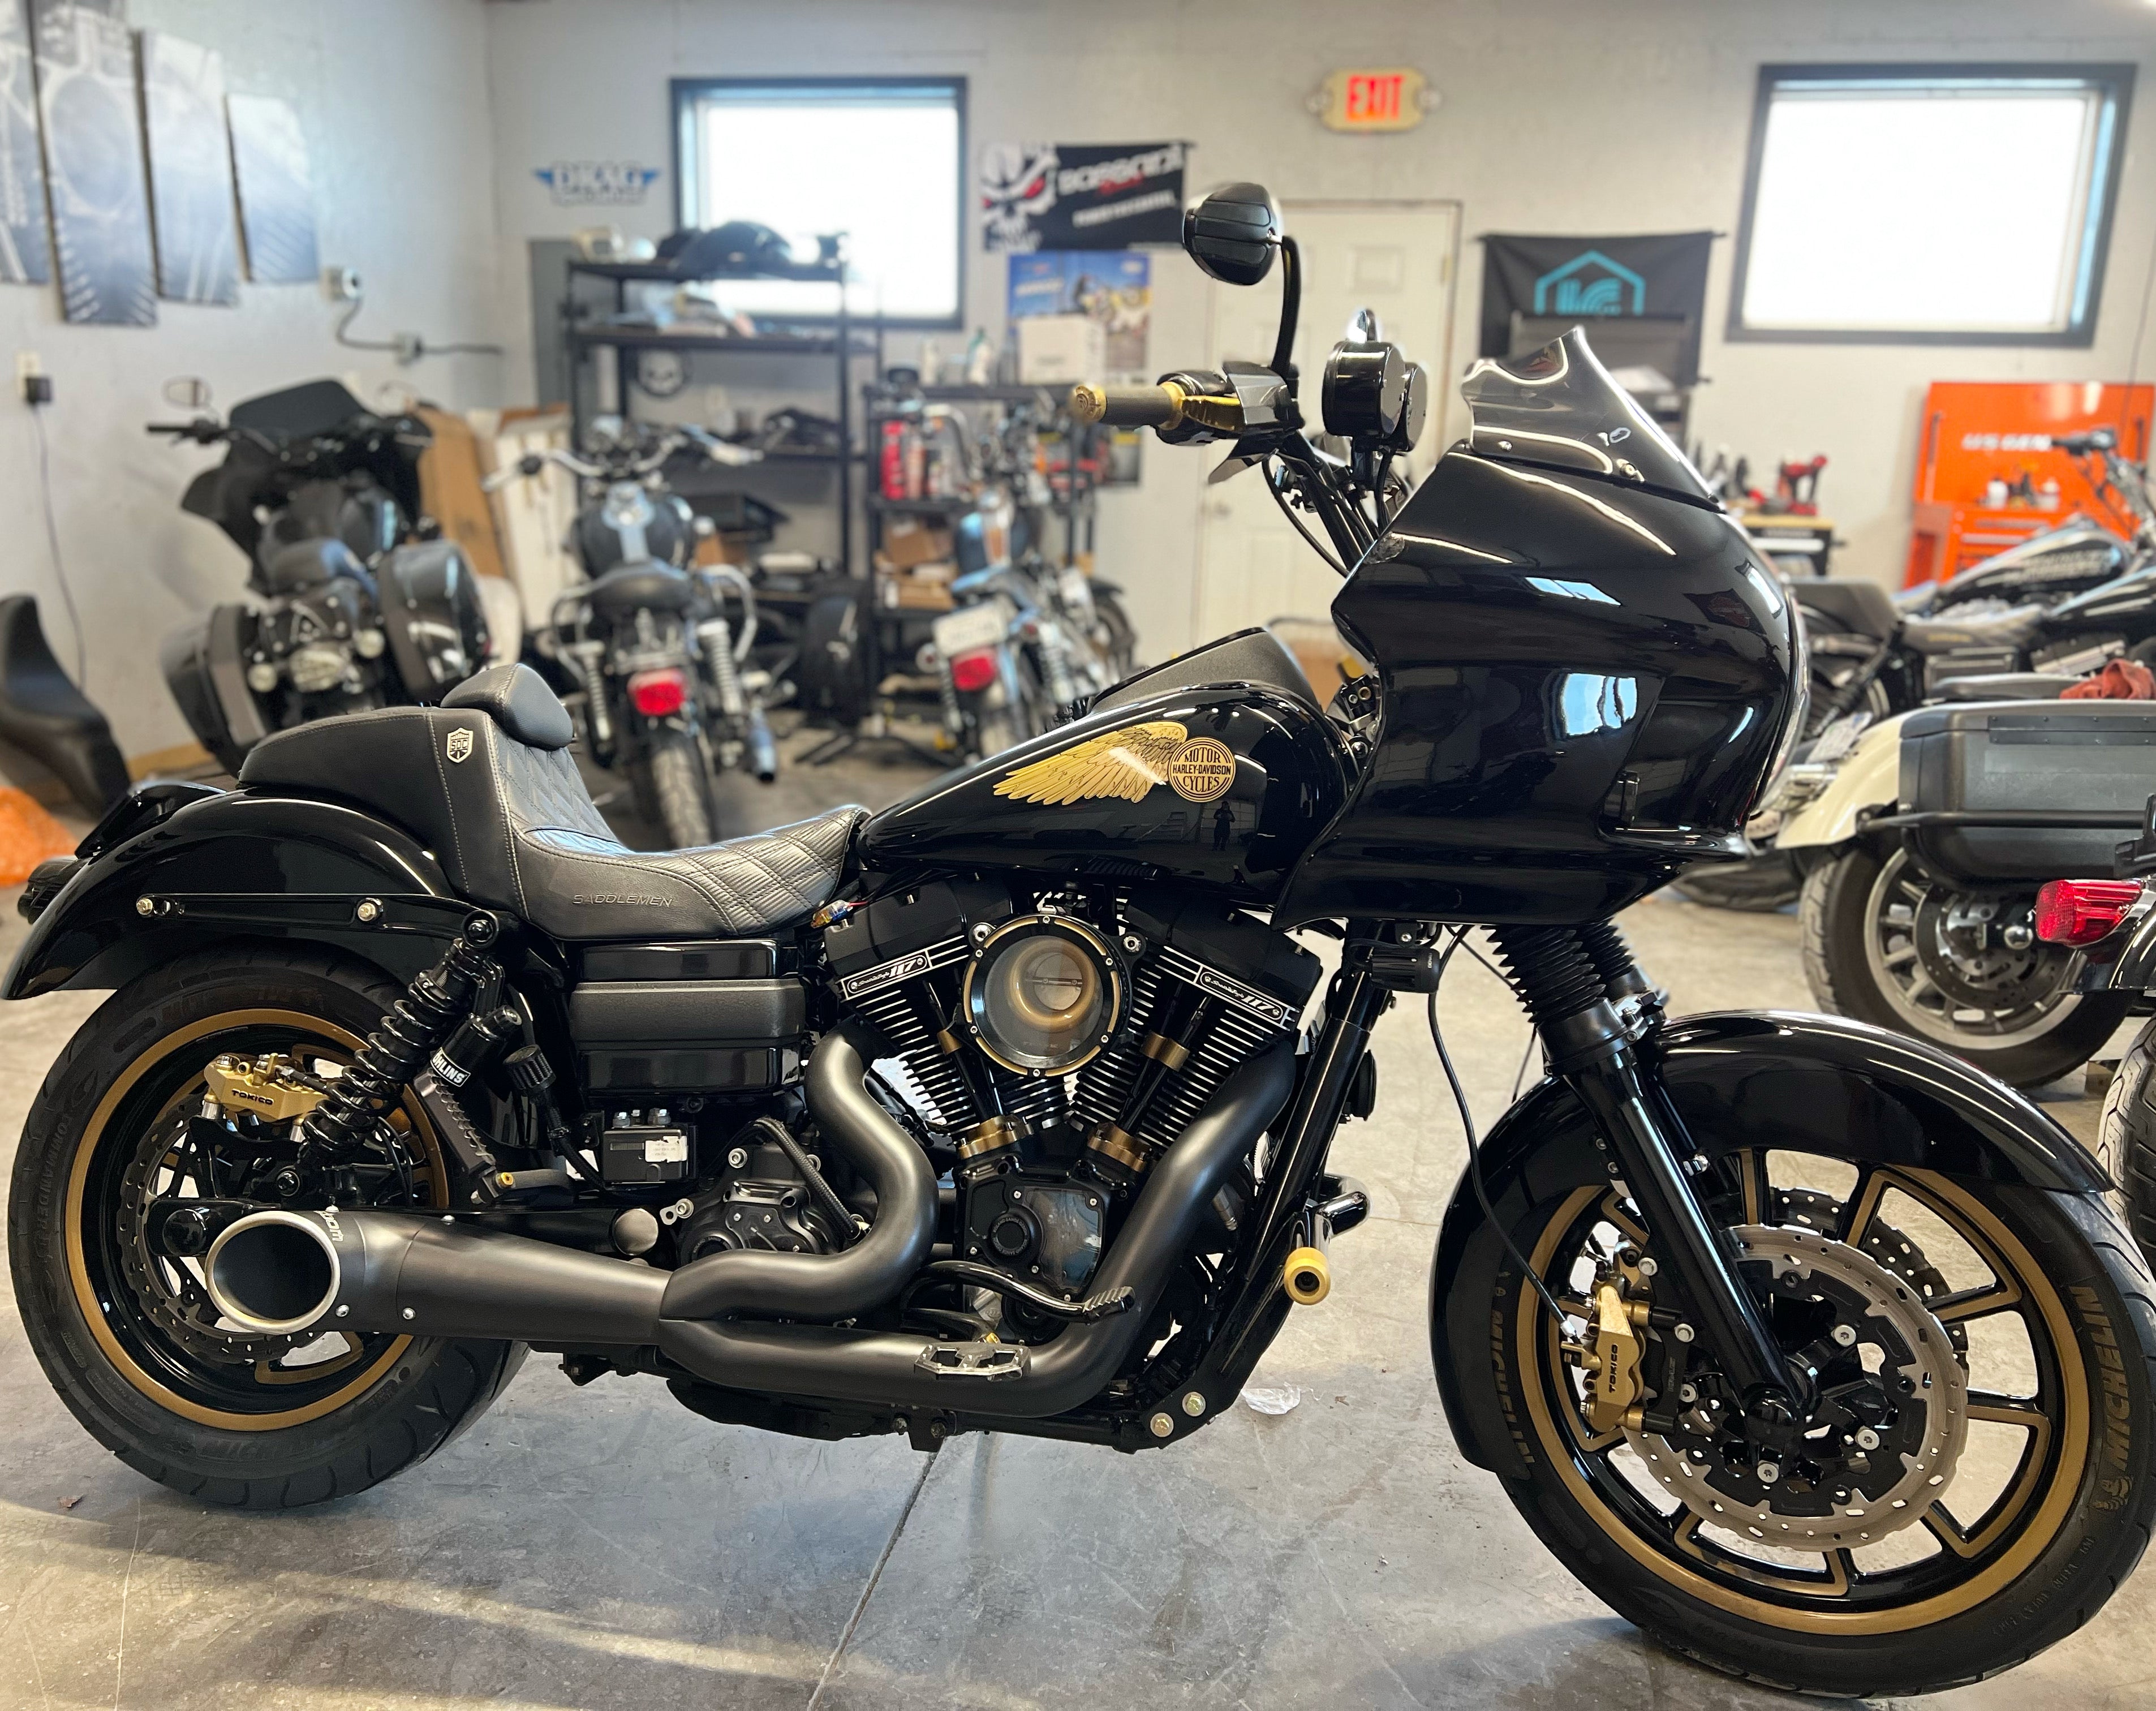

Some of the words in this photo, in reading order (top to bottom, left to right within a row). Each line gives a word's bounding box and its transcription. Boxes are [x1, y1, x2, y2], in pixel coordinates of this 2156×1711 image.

[1346, 76, 1405, 122] EXIT
[1184, 747, 1221, 763] MOTOR
[1173, 764, 1231, 775] HARLEY-DAVIDSON
[1183, 776, 1220, 792] CYCLES
[573, 894, 673, 908] SADDLEMEN
[889, 959, 917, 978] 117
[1241, 995, 1275, 1011] 117
[231, 1087, 275, 1106] TOKICO
[1608, 1344, 1619, 1394] TOKICO
[2069, 1286, 2131, 1471] MICHELIN
